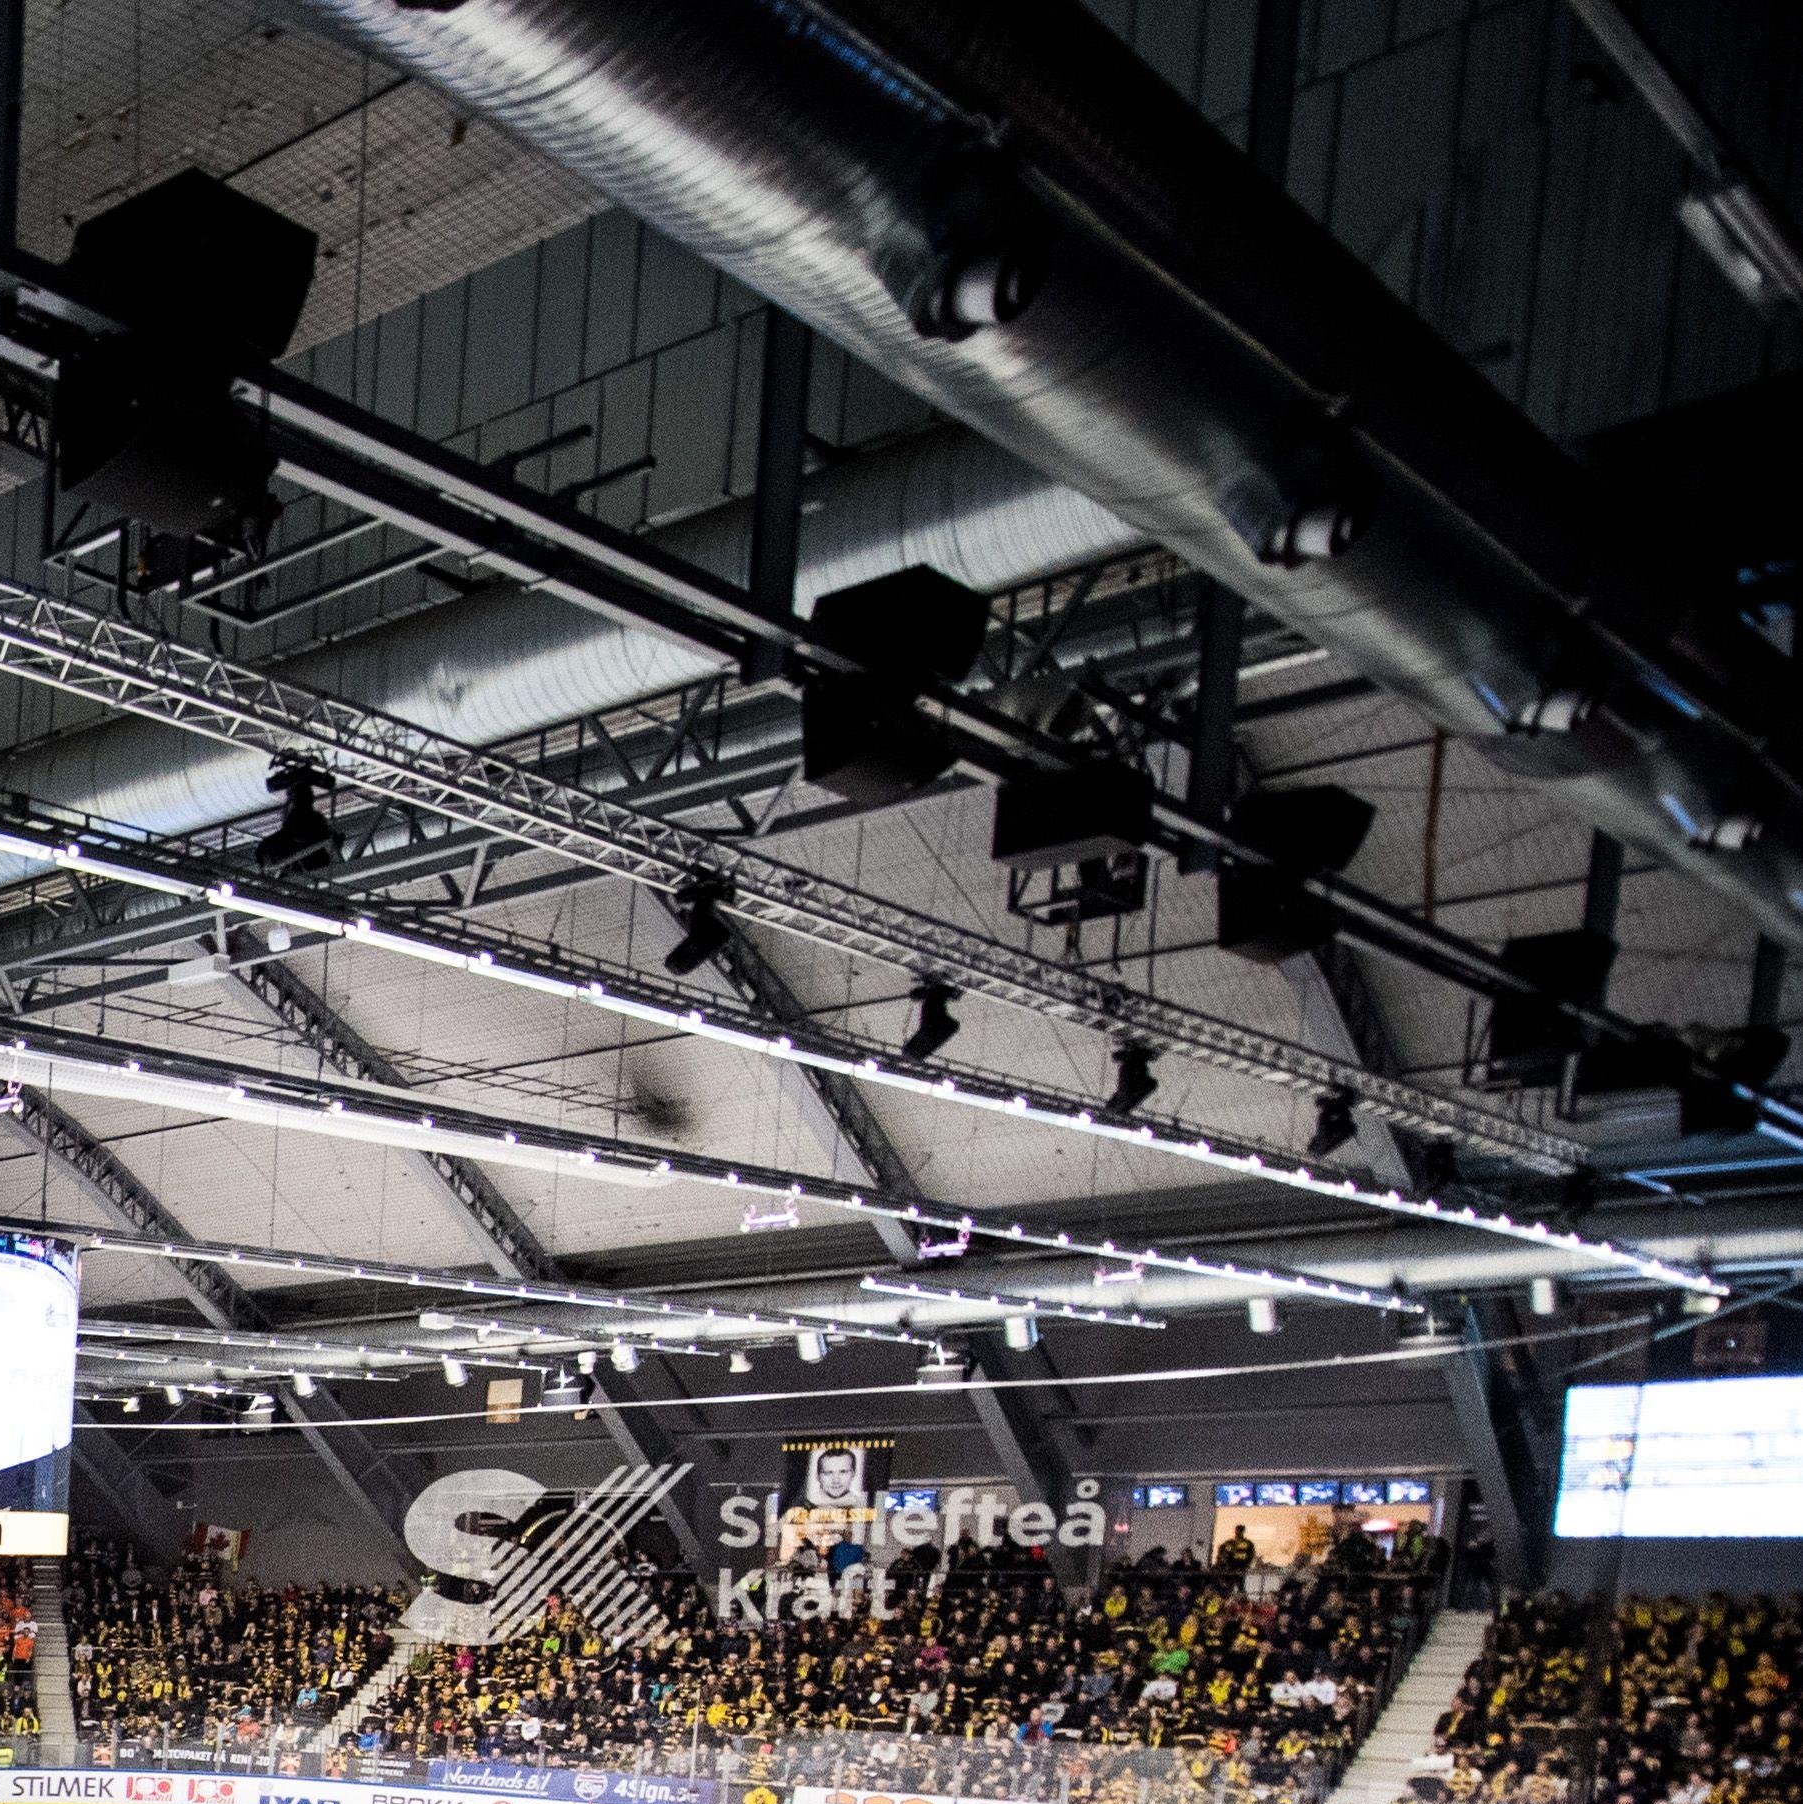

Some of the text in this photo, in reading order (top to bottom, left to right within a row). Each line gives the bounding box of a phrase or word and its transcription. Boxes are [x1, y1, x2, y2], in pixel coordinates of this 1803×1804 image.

[718, 1479, 1106, 1548] Skellefteå
[718, 1563, 896, 1629] Kraft
[443, 1766, 523, 1790] Norrlands
